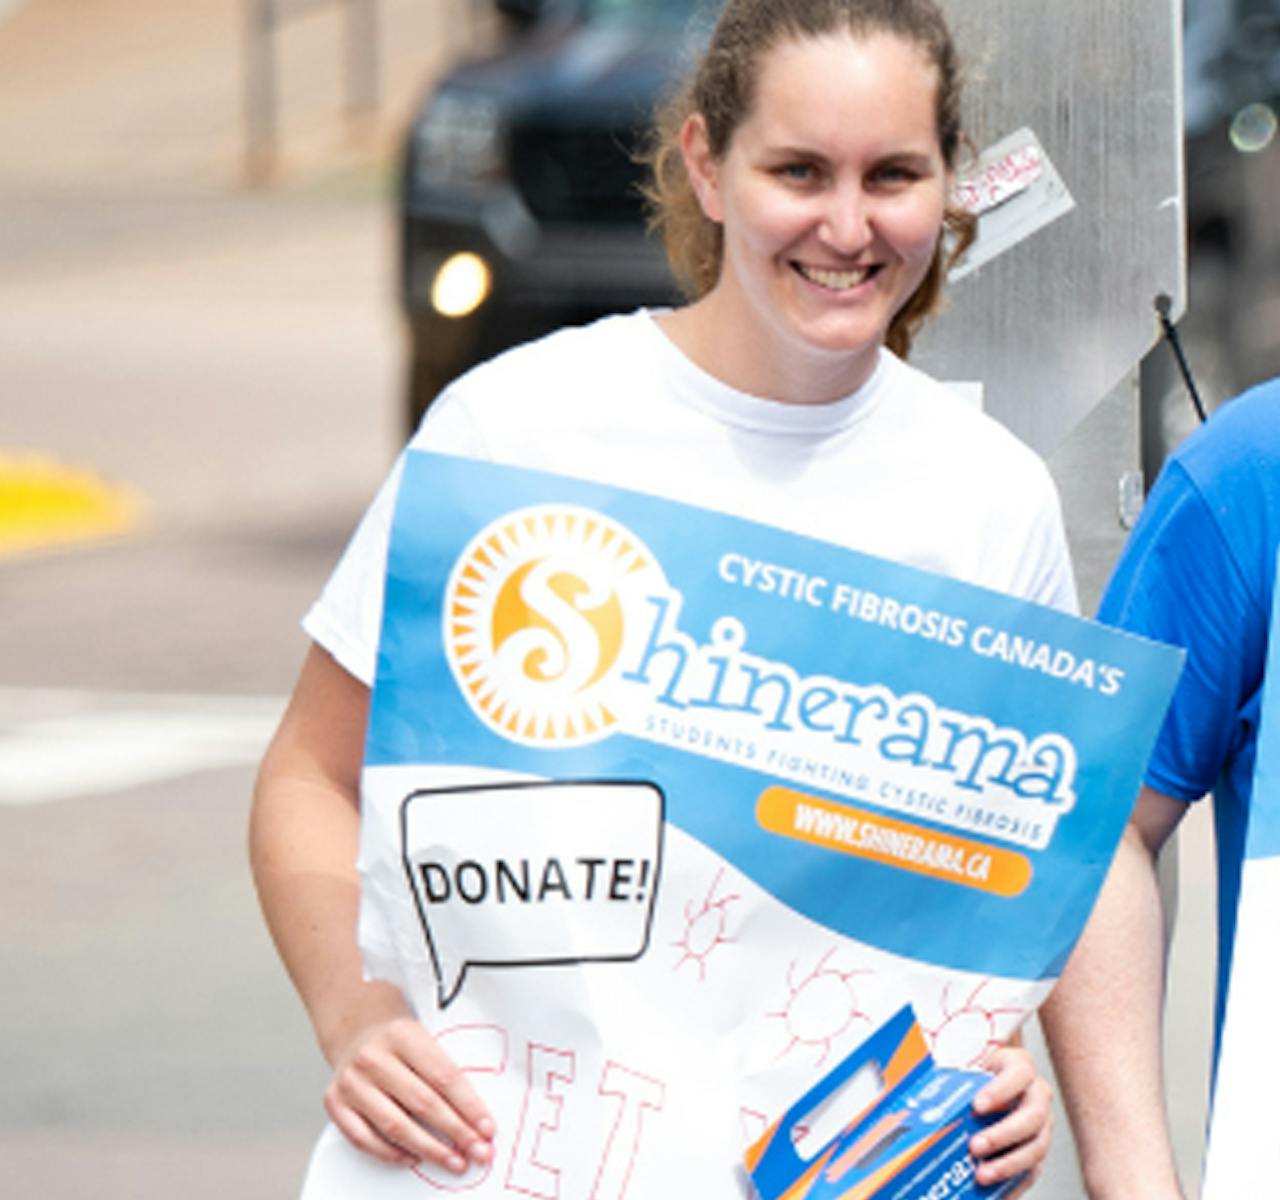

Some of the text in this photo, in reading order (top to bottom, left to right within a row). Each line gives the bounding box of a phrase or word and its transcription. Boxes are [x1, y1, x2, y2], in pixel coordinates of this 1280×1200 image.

[492, 552, 1065, 808] Shinerama
[718, 553, 1125, 696] CYSTIC FIBROSIS CANADA'S
[645, 714, 1042, 842] STUDENTS FIGHTING CYSTIC FIBROSIS
[794, 801, 992, 881] WWW.SHINERAMA.CA
[418, 857, 650, 904] DONATE!
